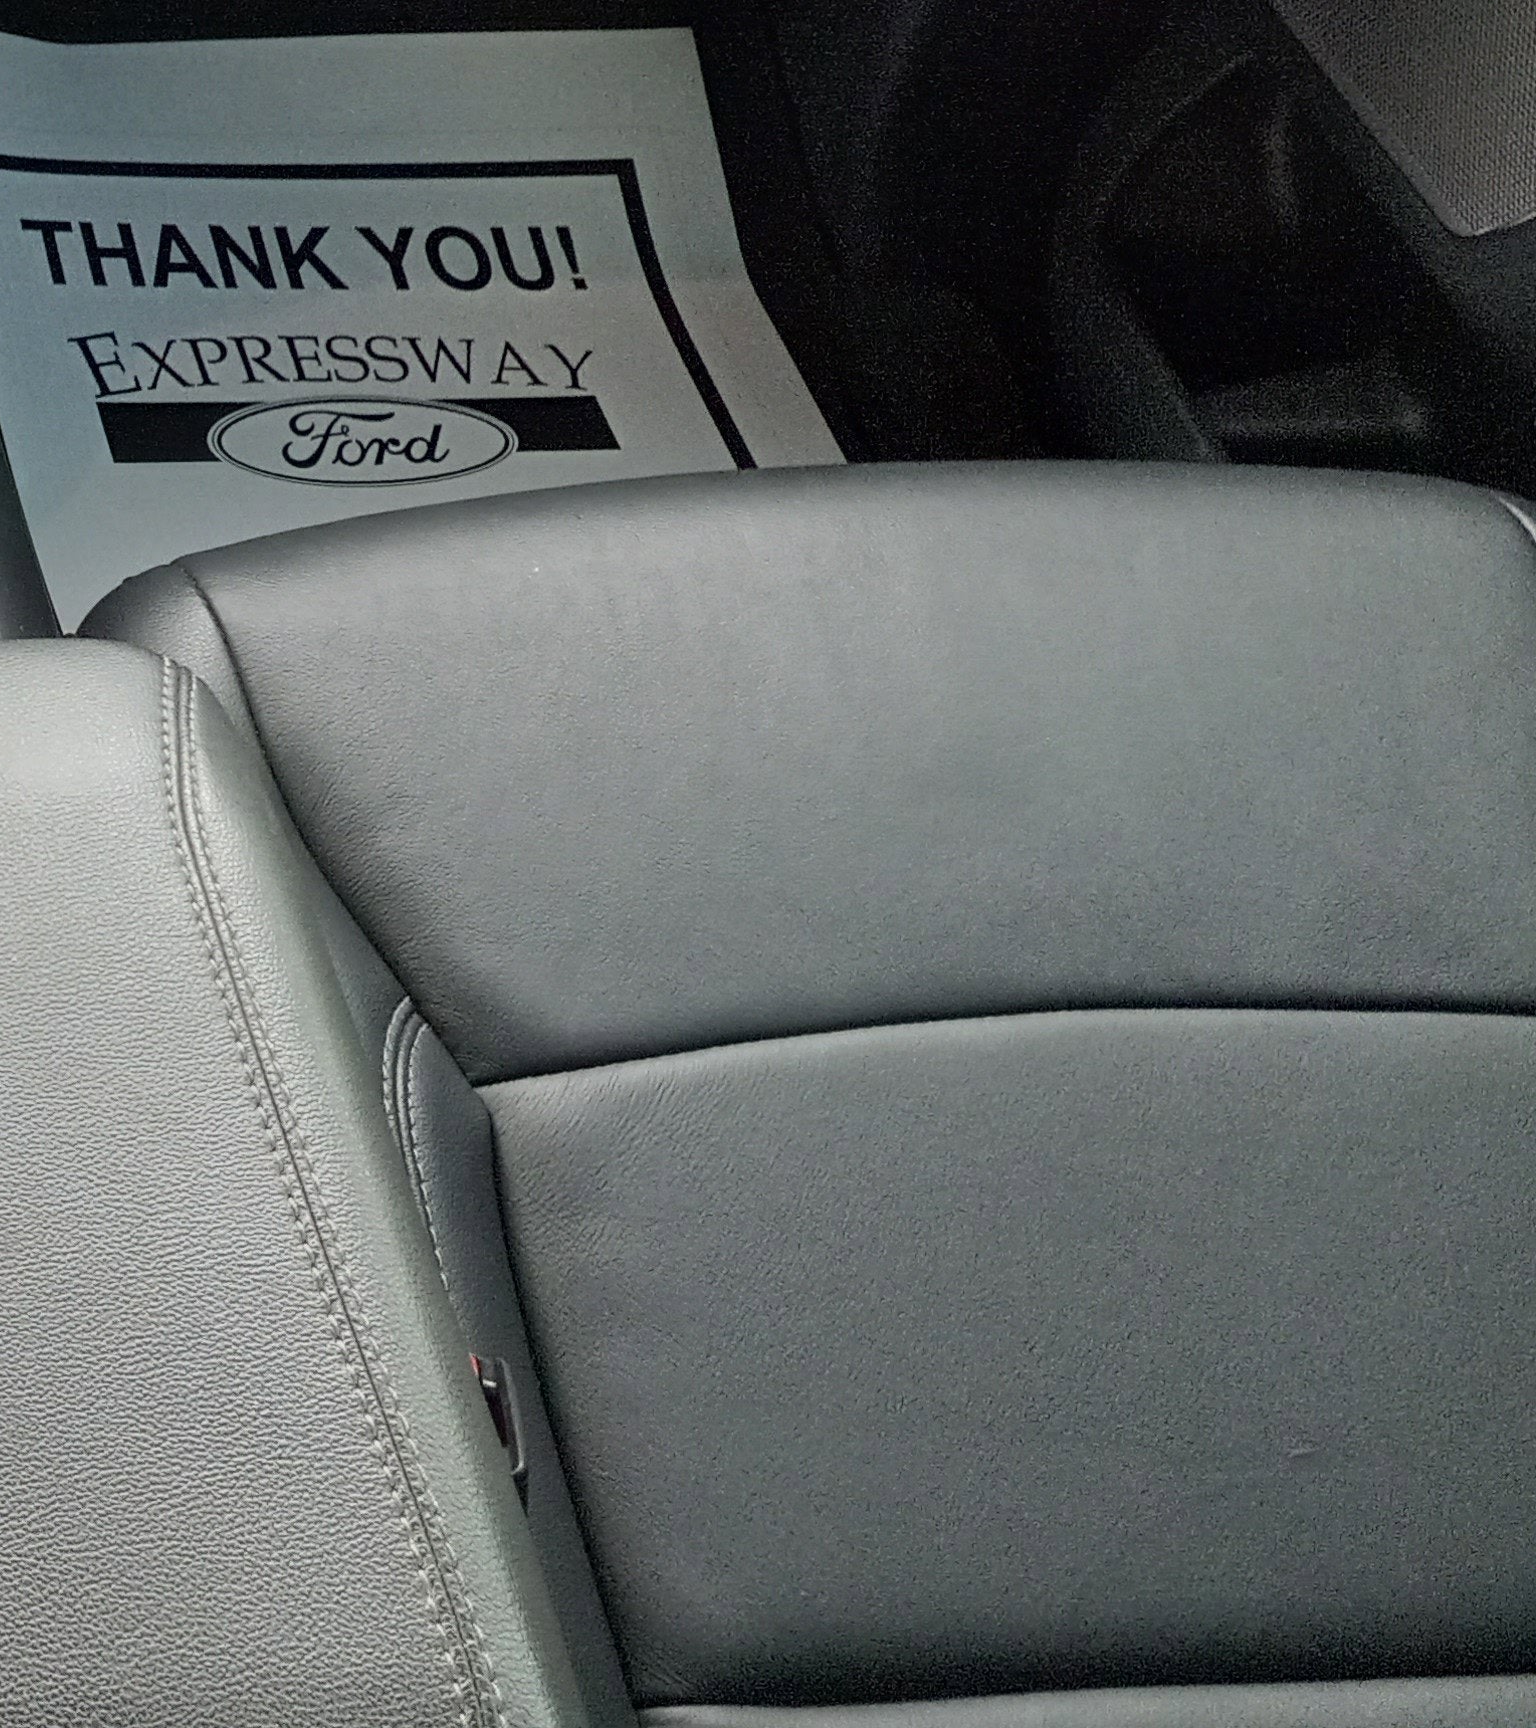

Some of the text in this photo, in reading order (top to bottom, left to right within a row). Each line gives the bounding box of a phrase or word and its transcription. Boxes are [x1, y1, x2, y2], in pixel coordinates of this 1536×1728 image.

[20, 218, 590, 293] THANK YOU!
[68, 331, 595, 399] EXPRESSWAY
[280, 407, 451, 471] Ford
